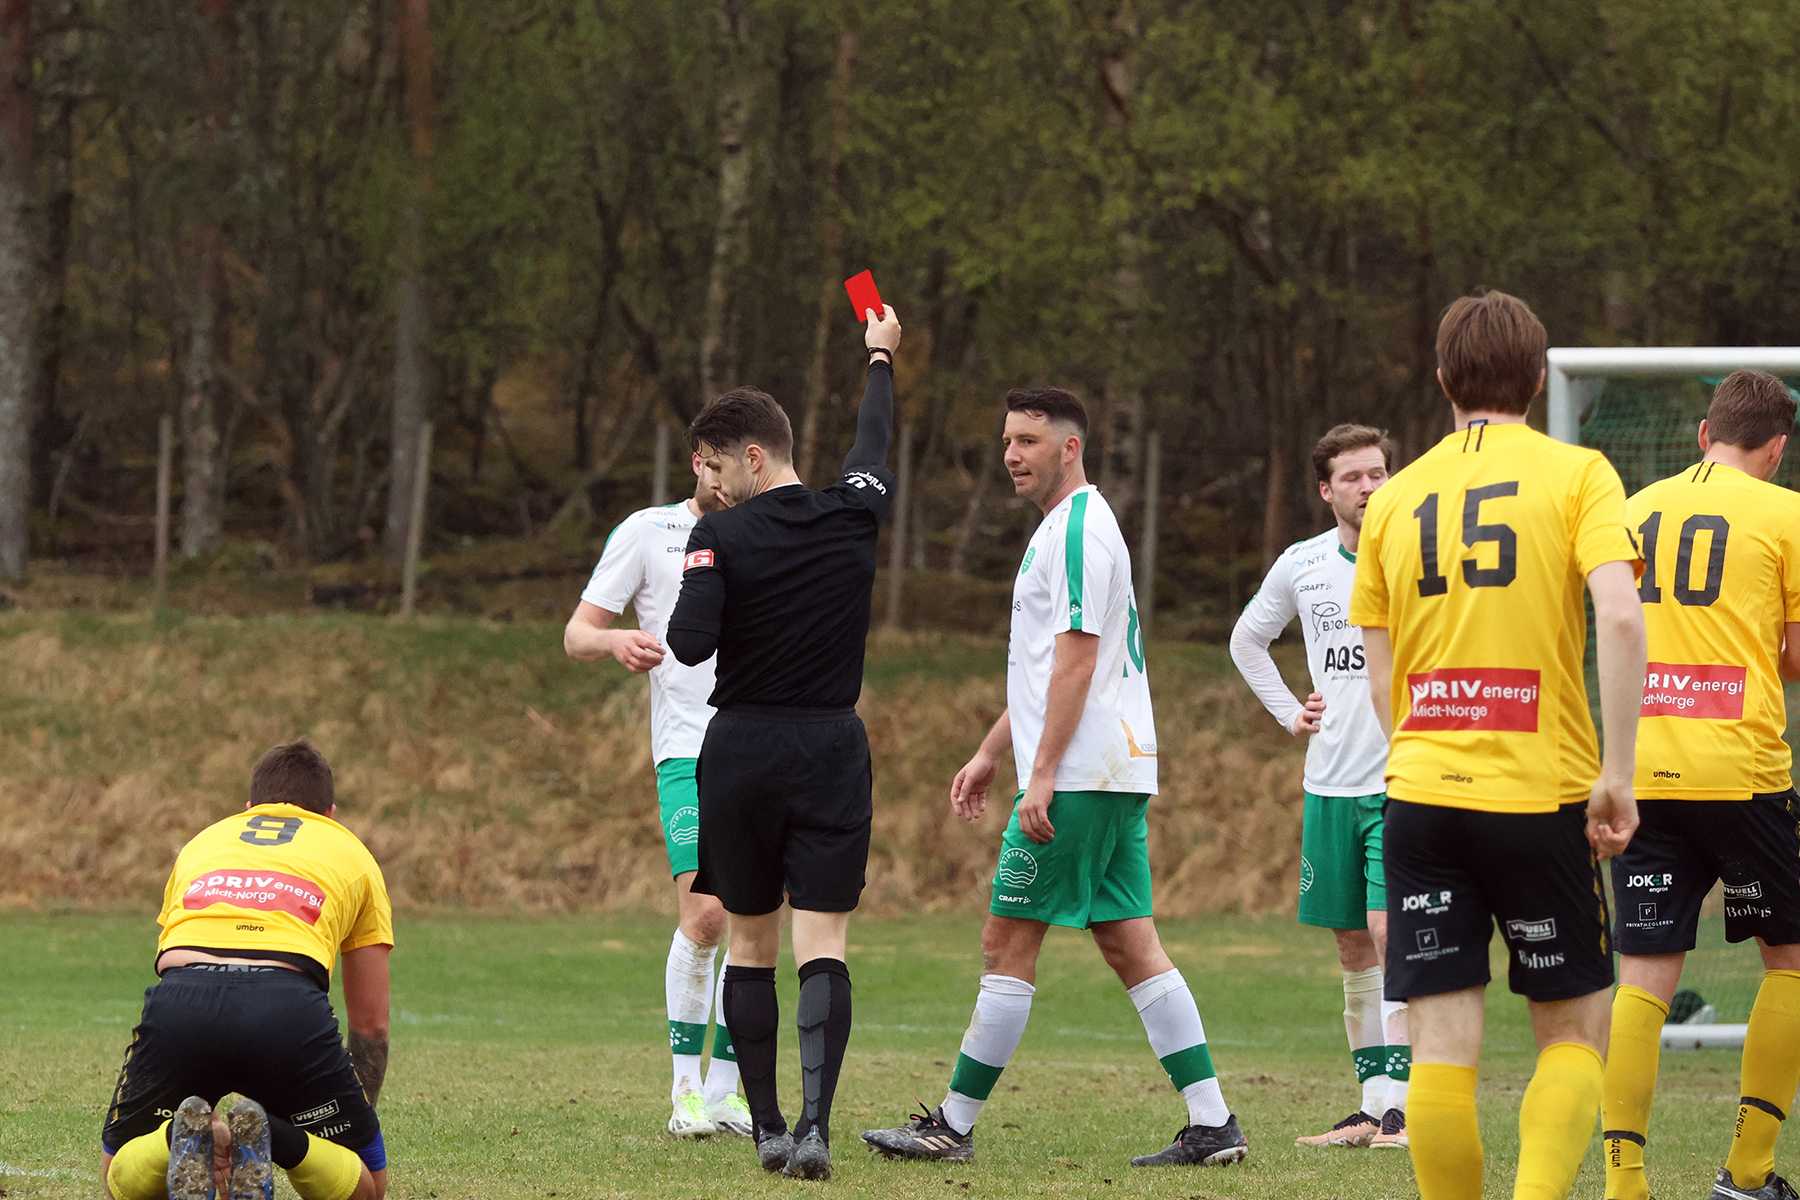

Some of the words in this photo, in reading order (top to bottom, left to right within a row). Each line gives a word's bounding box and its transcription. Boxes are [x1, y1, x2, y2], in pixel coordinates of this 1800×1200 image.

[1413, 481, 1519, 598] 15
[1307, 552, 1328, 567] NTE
[1637, 511, 1731, 607] 10
[1299, 583, 1326, 593] CRAFT
[1322, 619, 1358, 632] BJØR
[1324, 644, 1366, 673] AQS
[1482, 684, 1538, 704] energi
[1691, 679, 1744, 696] energi
[1640, 692, 1696, 709] idt-Norge
[1412, 704, 1488, 721] Midt-Norge
[1441, 773, 1473, 784] umbro
[1653, 770, 1681, 779] umbro
[239, 814, 304, 846] 9
[1626, 873, 1673, 888] JOKER
[204, 888, 277, 904] Midt-Norge
[207, 875, 275, 889] DRIV
[274, 881, 323, 908] energi
[998, 894, 1024, 903] CRAFT
[1648, 886, 1669, 894] engros
[1401, 890, 1453, 912] JOKER
[236, 923, 265, 933] umbro
[295, 1105, 336, 1121] VISUELL
[314, 1120, 352, 1139] ohus
[1735, 1107, 1748, 1138] umbro
[1609, 1138, 1621, 1167] umbro
